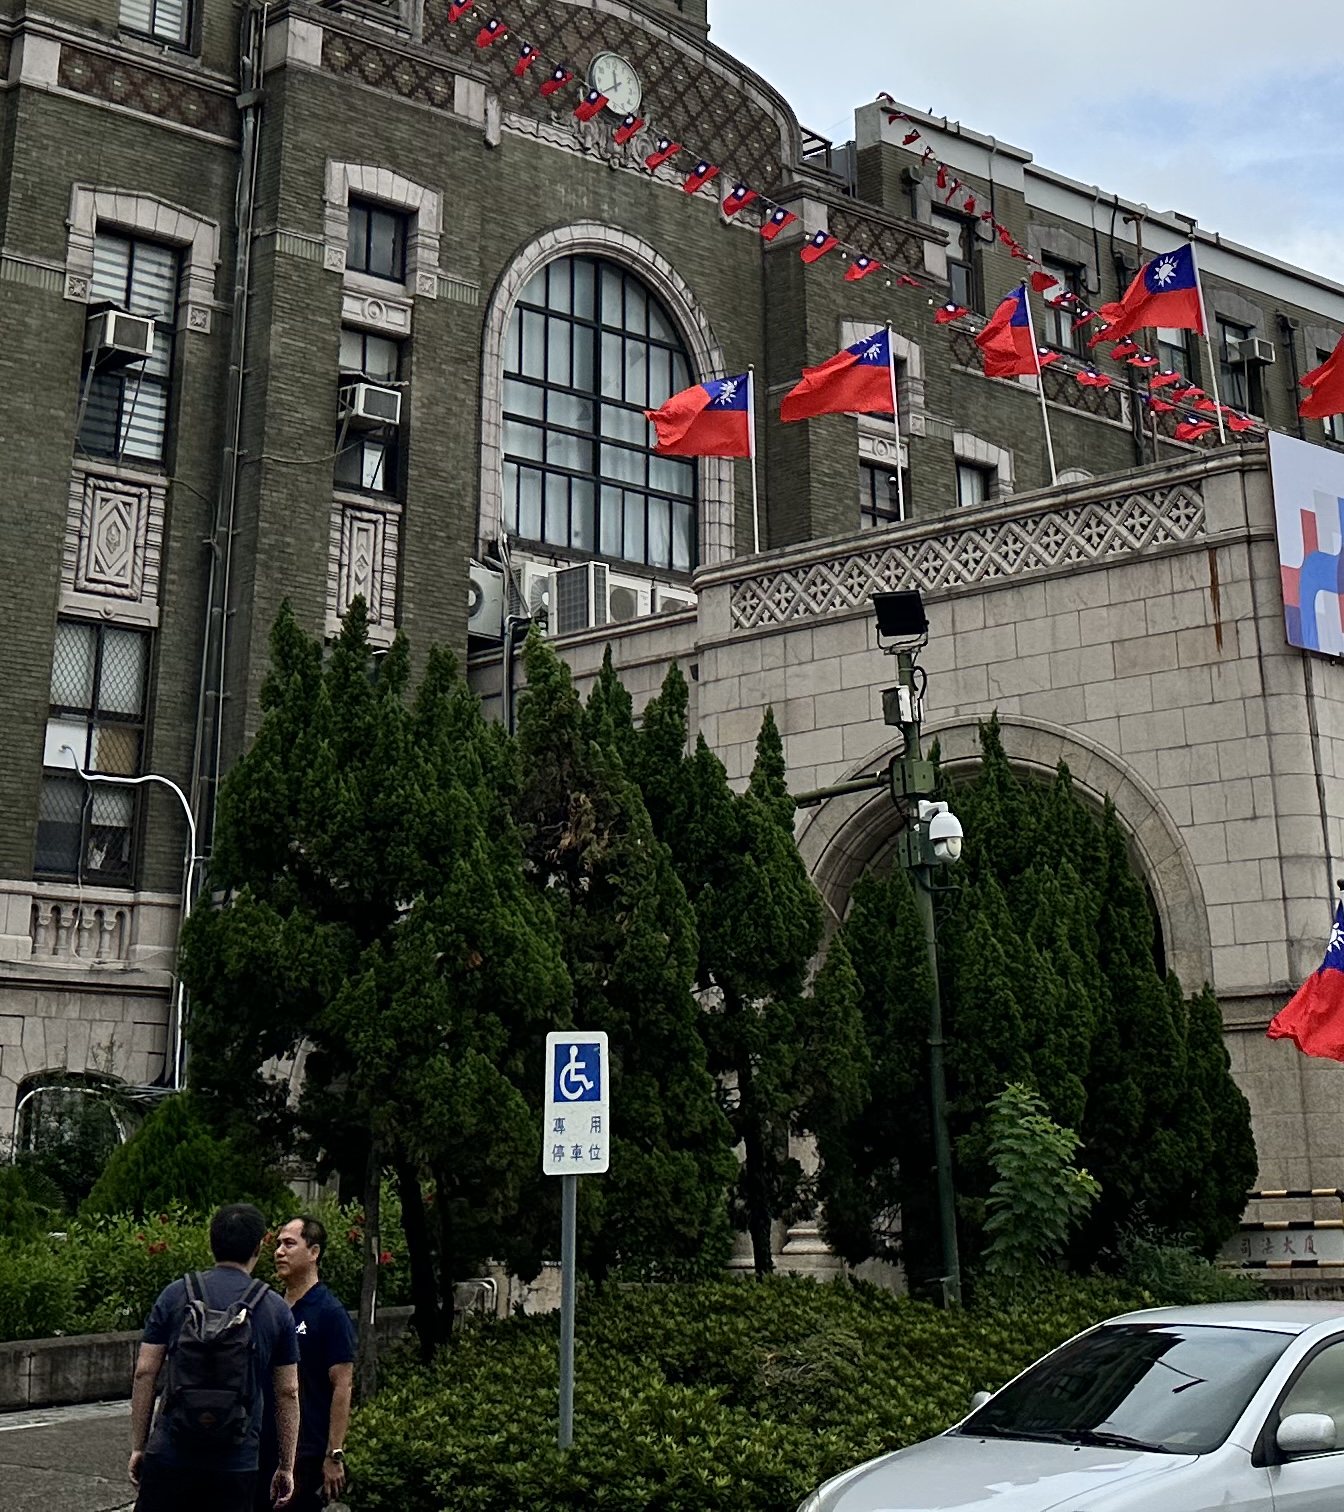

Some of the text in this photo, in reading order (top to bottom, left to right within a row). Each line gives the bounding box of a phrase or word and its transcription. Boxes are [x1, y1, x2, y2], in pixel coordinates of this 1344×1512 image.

[552, 1115, 602, 1136] 專用
[552, 1143, 602, 1163] 停車位
[1241, 1234, 1318, 1258] 司法大廈
